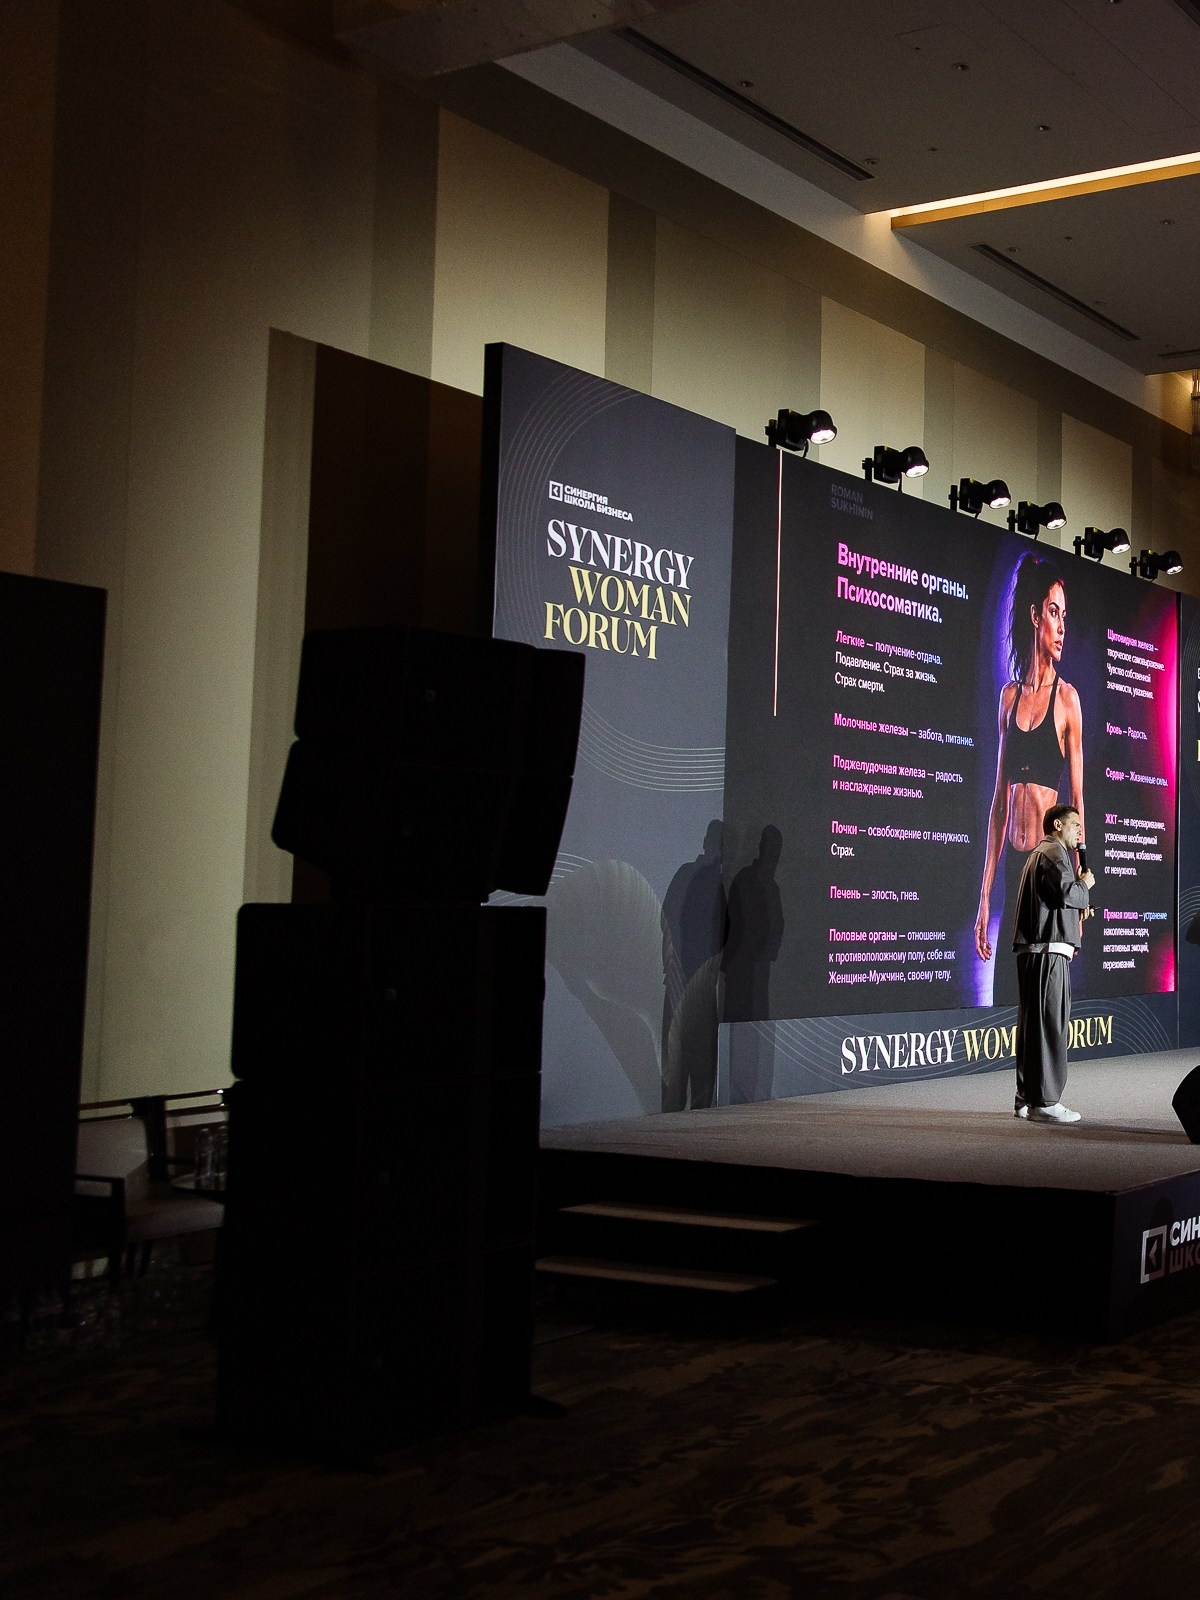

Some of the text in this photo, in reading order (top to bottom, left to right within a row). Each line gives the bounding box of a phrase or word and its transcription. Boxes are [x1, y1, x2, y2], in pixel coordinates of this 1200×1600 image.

[564, 485, 608, 505] СИНЕРГИЯ
[831, 483, 864, 504] ROMAN
[564, 494, 633, 522] ШКОЛА БИЗНЕСА
[547, 519, 694, 589] SYNERGY
[838, 542, 969, 599] Внутренние органы.
[568, 566, 692, 627] WOMAN
[837, 576, 942, 623] Психосоматика.
[543, 602, 658, 659] FORUM
[836, 630, 865, 648] Легкие
[875, 642, 943, 665] получение-отдача.
[835, 651, 938, 684] Подавление. Страх за жизнь.
[835, 672, 885, 693] Страх смерти.
[833, 712, 877, 732] Молочные
[878, 722, 909, 737] железы
[918, 728, 944, 744] забота,
[945, 733, 975, 747] питание.
[1106, 722, 1122, 735] Кровь
[833, 754, 897, 775] Поджелудочная
[898, 766, 926, 779] железа
[935, 770, 963, 784] радость
[1106, 767, 1124, 781] Сердце
[832, 780, 924, 799] и наслаждение жизнью.
[831, 820, 857, 835] Почки
[867, 825, 921, 840] освобождение
[923, 830, 930, 840] от
[932, 831, 970, 844] ненужного.
[831, 843, 855, 859] Страх.
[830, 885, 861, 900] Печень
[871, 889, 899, 902] злость,
[900, 890, 919, 901] гнев.
[829, 928, 867, 942] Половые
[868, 930, 897, 943] органы
[907, 930, 946, 941] отношение
[829, 949, 955, 965] к противоположному полу, себе как
[828, 970, 952, 984] Женщине-Мужчине, своему телу.
[840, 1015, 1113, 1076] SYNERGY WOM RUM
